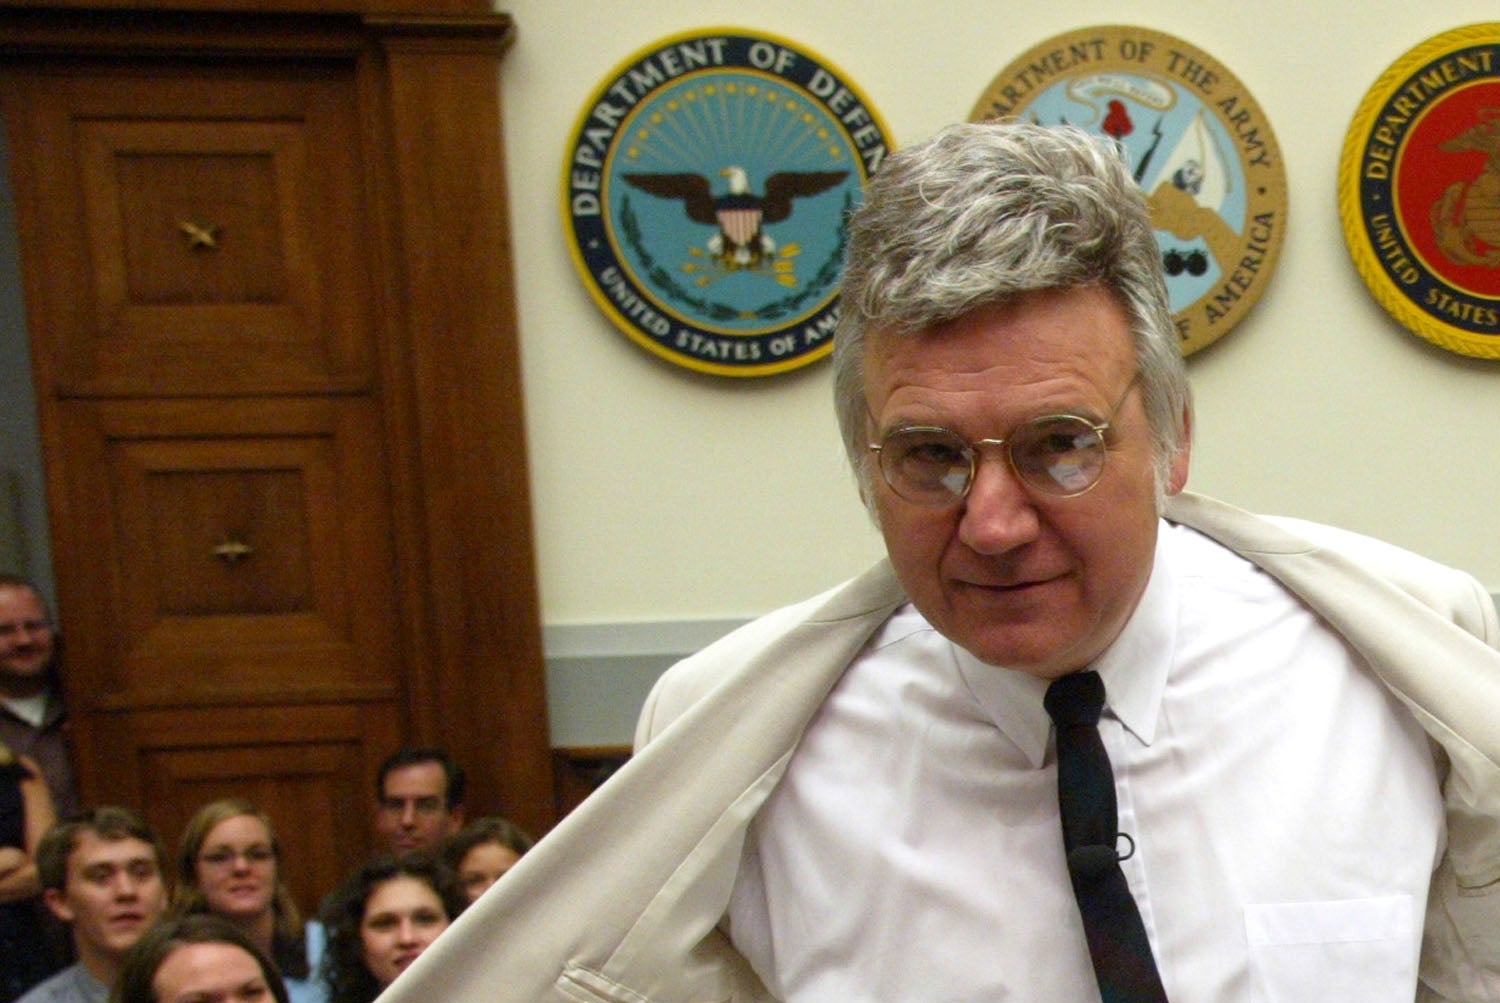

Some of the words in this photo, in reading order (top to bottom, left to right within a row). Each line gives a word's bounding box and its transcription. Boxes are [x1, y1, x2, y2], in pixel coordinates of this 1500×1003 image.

[572, 38, 728, 217] DEPARTMENT
[749, 42, 797, 73] OF
[809, 70, 885, 171] DEFEN
[984, 38, 1106, 120] ARTMENT
[1121, 40, 1154, 62] OF
[1168, 51, 1217, 94] THE
[1218, 95, 1271, 169] ARMY
[1367, 52, 1493, 181] DEPARTMENT
[599, 266, 670, 336] UNITED
[675, 330, 761, 361] STATES
[768, 333, 798, 357] OF
[1175, 318, 1191, 342] F
[1204, 210, 1276, 326] AMERICA
[1370, 213, 1421, 285] UNITED
[1424, 288, 1499, 327] STATES
